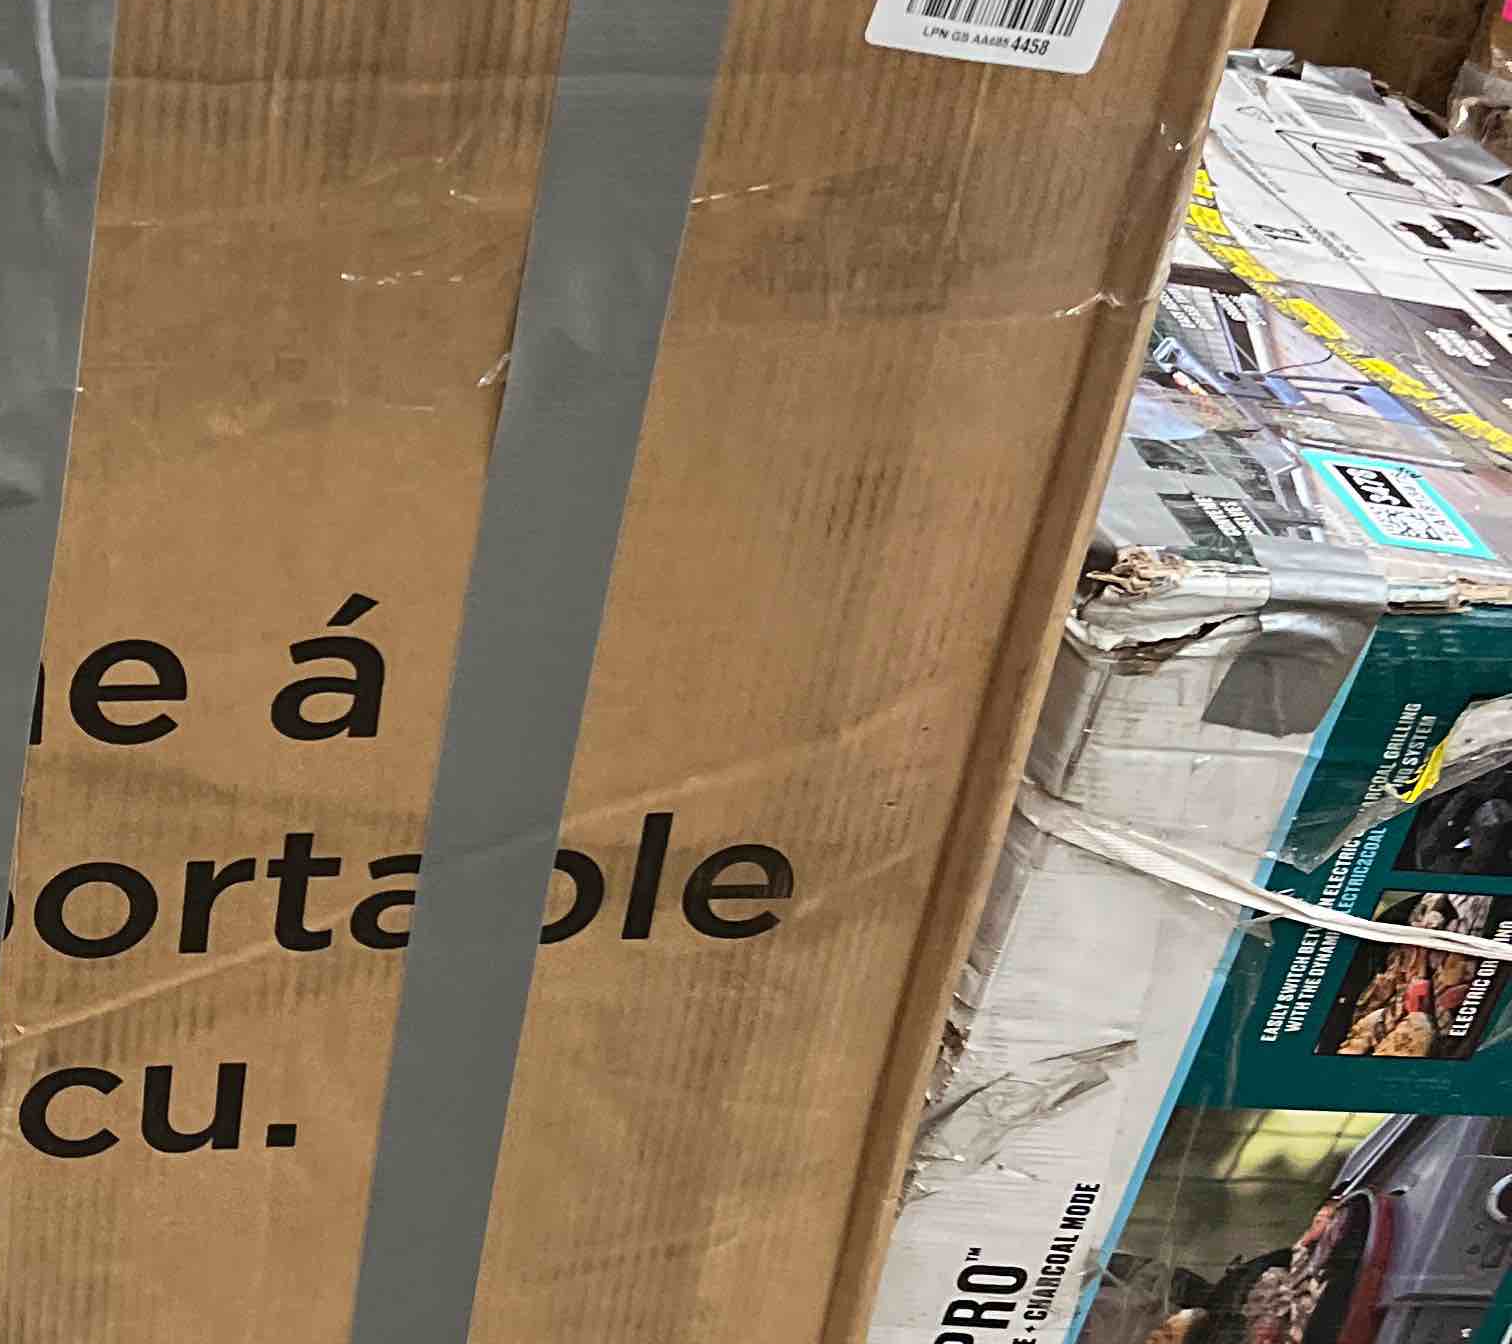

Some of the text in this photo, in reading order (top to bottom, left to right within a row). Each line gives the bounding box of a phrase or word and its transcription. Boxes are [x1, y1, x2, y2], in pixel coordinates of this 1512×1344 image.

[1011, 36, 1051, 57] 4458
[270, 593, 385, 741] á
[1260, 1003, 1287, 1042] EASILY
[1277, 957, 1307, 1002] SWITCH
[1325, 838, 1362, 896] ELECTRIC
[1383, 703, 1422, 760] GRILLING
[1284, 715, 1437, 1033] WITH THE DYNAMI LECTRIC2COAL SYSTEM
[1448, 979, 1491, 1037] ELECTRIC
[19, 1062, 298, 1159] cu.
[1023, 1230, 1080, 1322] CHARCOAL
[1062, 1183, 1102, 1230] MODE
